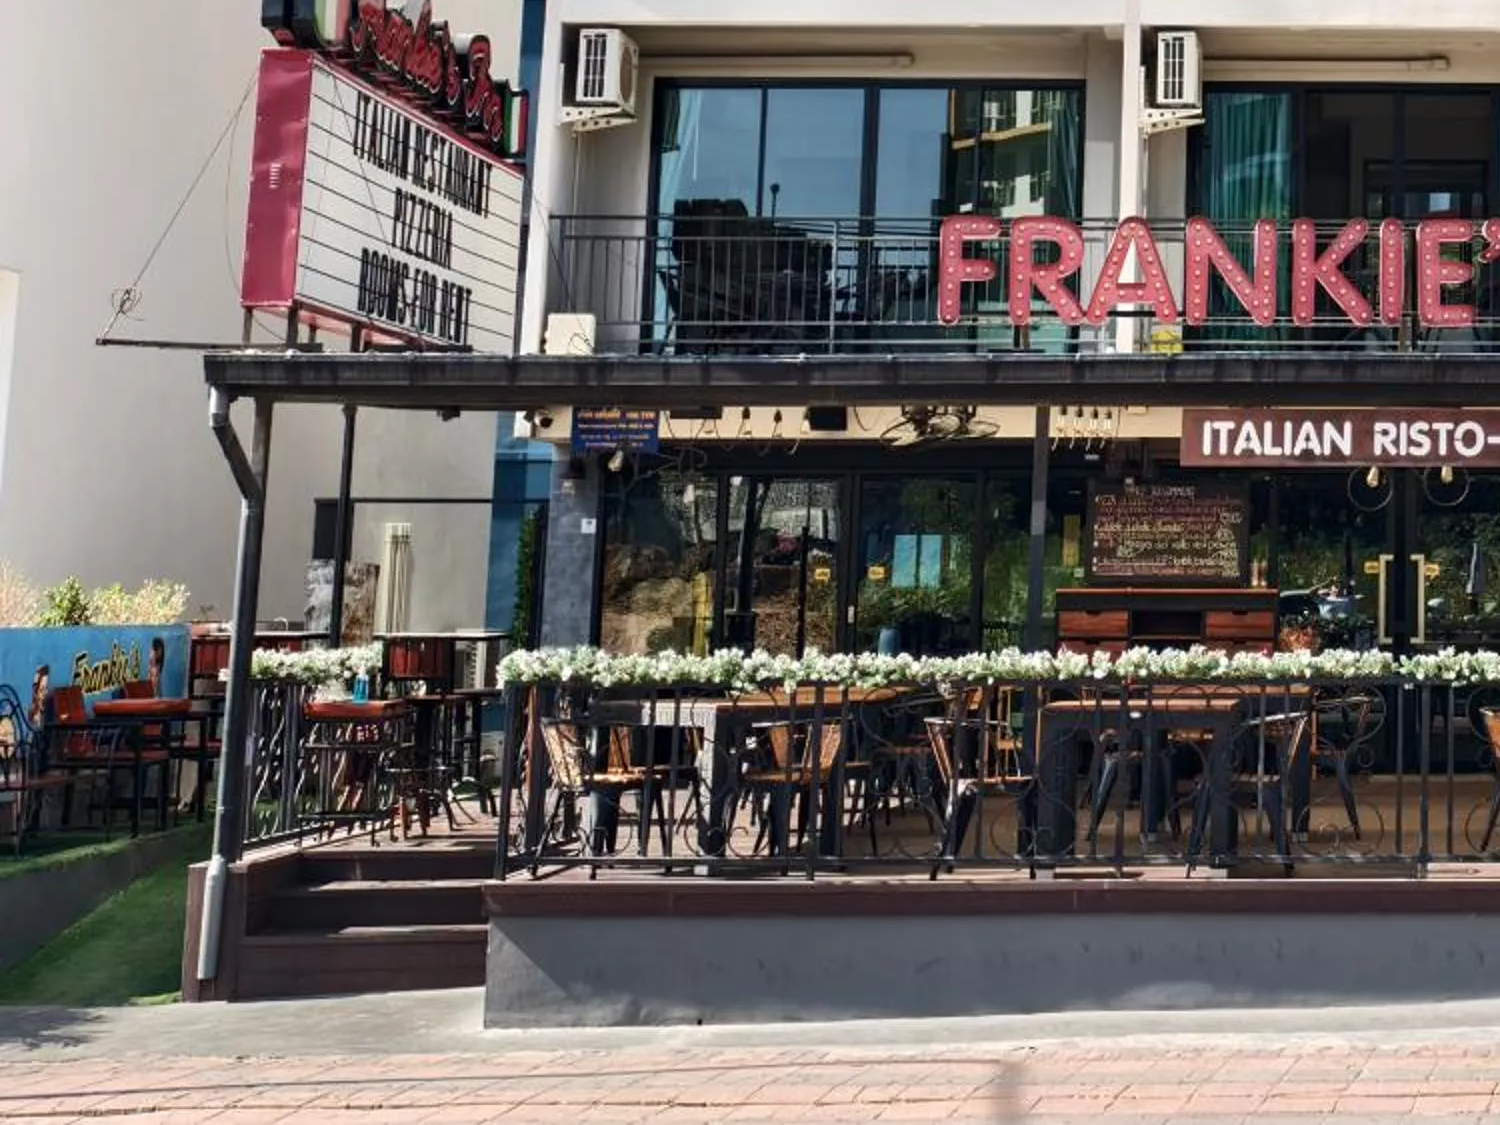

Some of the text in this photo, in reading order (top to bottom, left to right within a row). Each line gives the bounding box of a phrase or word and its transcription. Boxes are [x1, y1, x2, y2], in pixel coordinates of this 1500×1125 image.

[354, 89, 493, 219] ITALIAN RESTAURANT
[392, 187, 453, 269] PIZZERIA
[358, 247, 472, 346] ROOMS FOR RENT
[1202, 420, 1352, 456] ITALIAN
